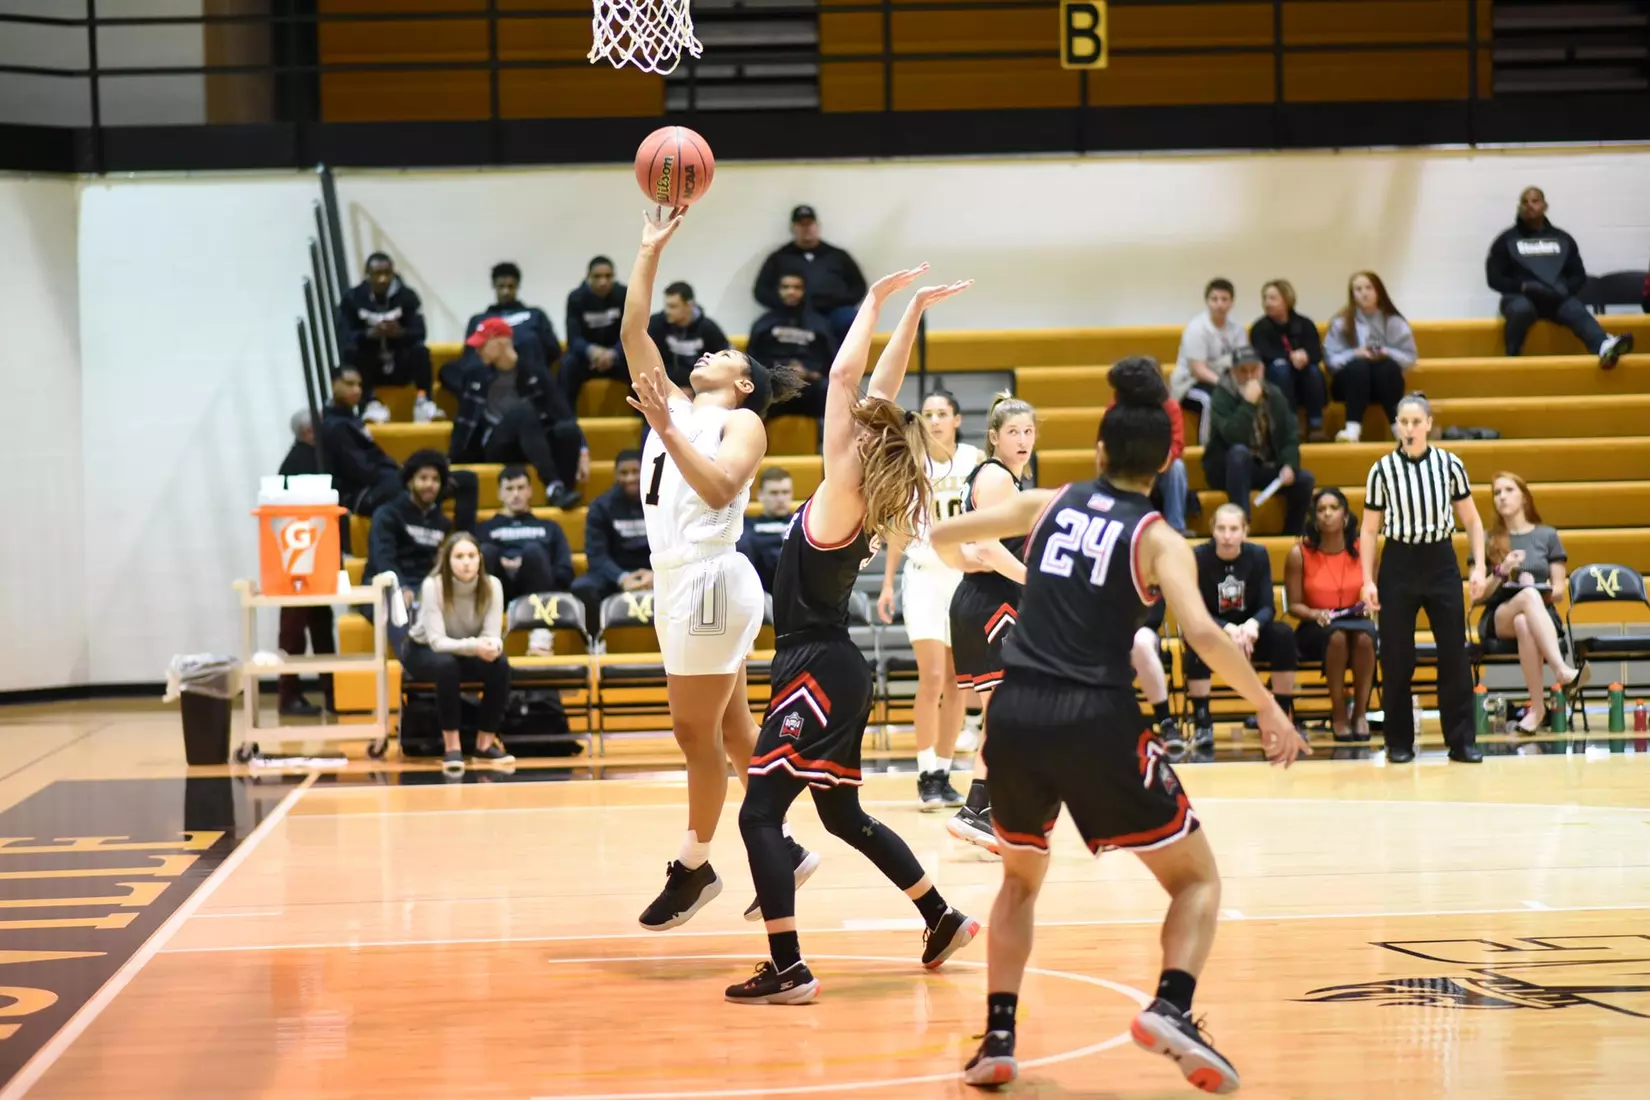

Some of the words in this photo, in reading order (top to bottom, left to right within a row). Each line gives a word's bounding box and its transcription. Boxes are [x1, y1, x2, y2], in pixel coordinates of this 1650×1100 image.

[1066, 4, 1101, 64] B
[656, 155, 674, 203] Wilson
[683, 164, 696, 198] NCAA
[645, 451, 666, 506] 1
[285, 520, 312, 550] G
[1040, 507, 1124, 587] 24
[1589, 566, 1623, 598] M
